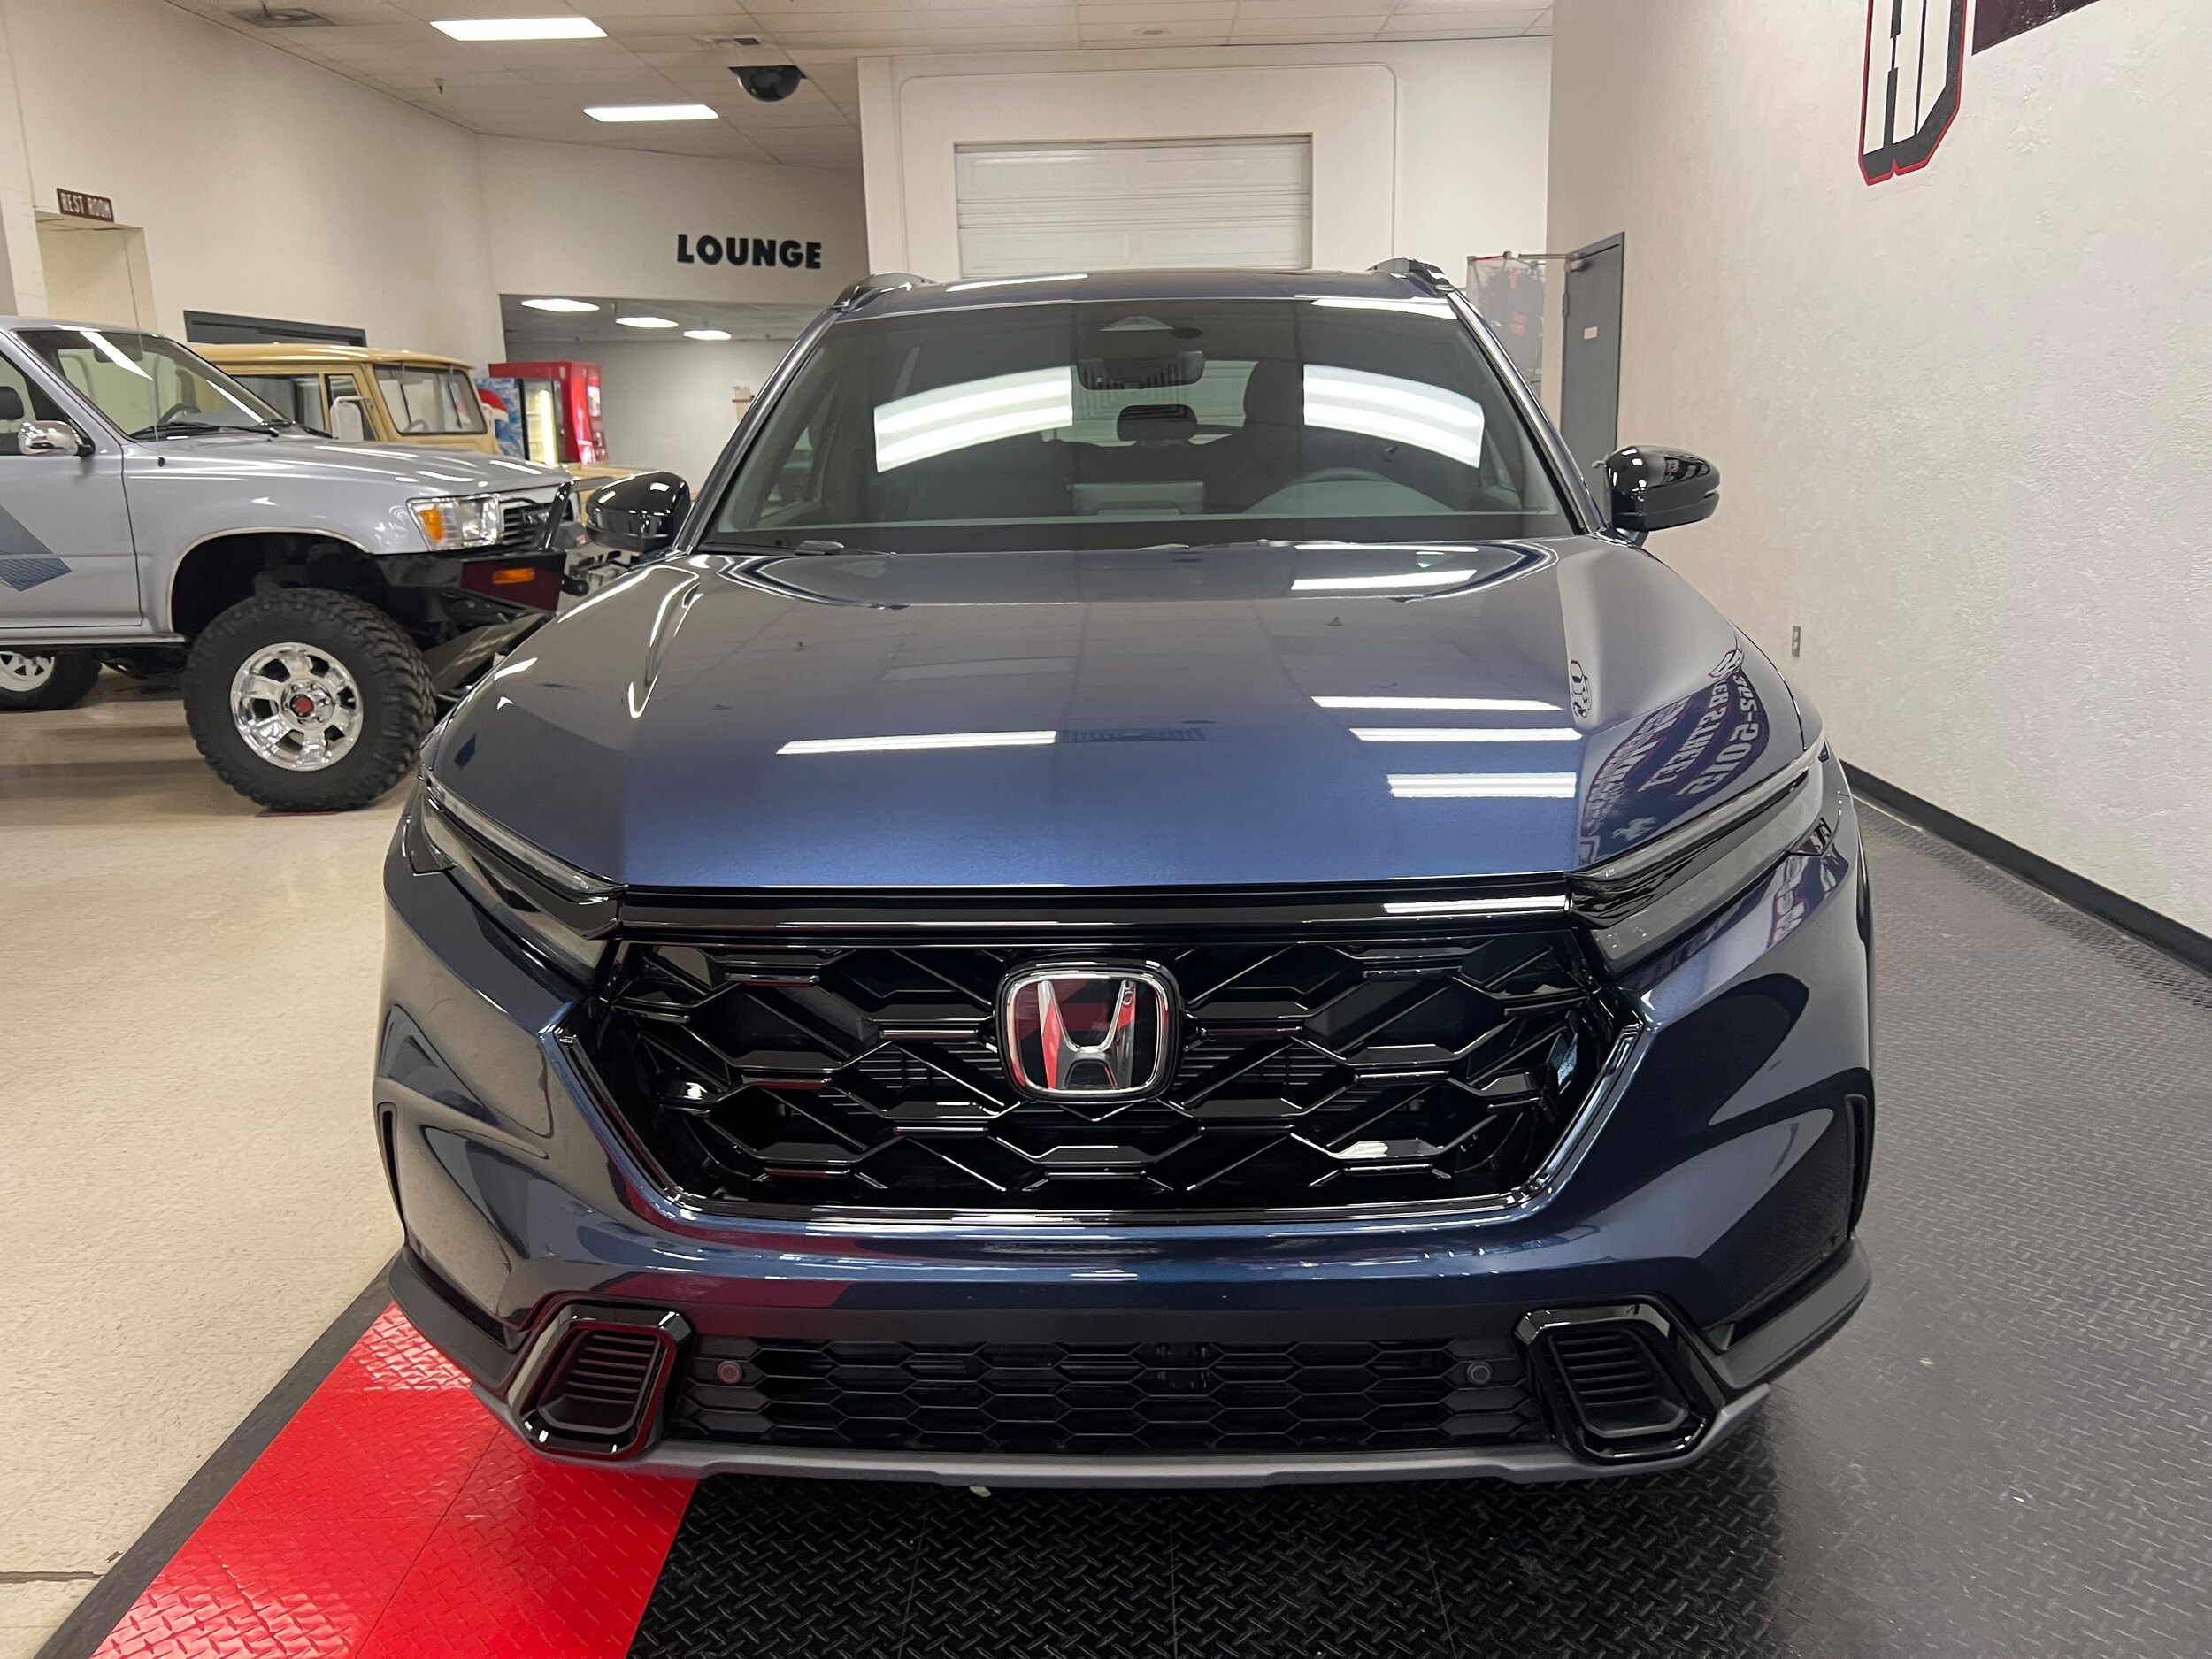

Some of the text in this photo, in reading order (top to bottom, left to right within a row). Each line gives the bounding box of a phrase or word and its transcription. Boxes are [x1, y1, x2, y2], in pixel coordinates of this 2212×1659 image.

[60, 192, 111, 219] REST ROOM
[677, 234, 821, 269] LOUNGE
